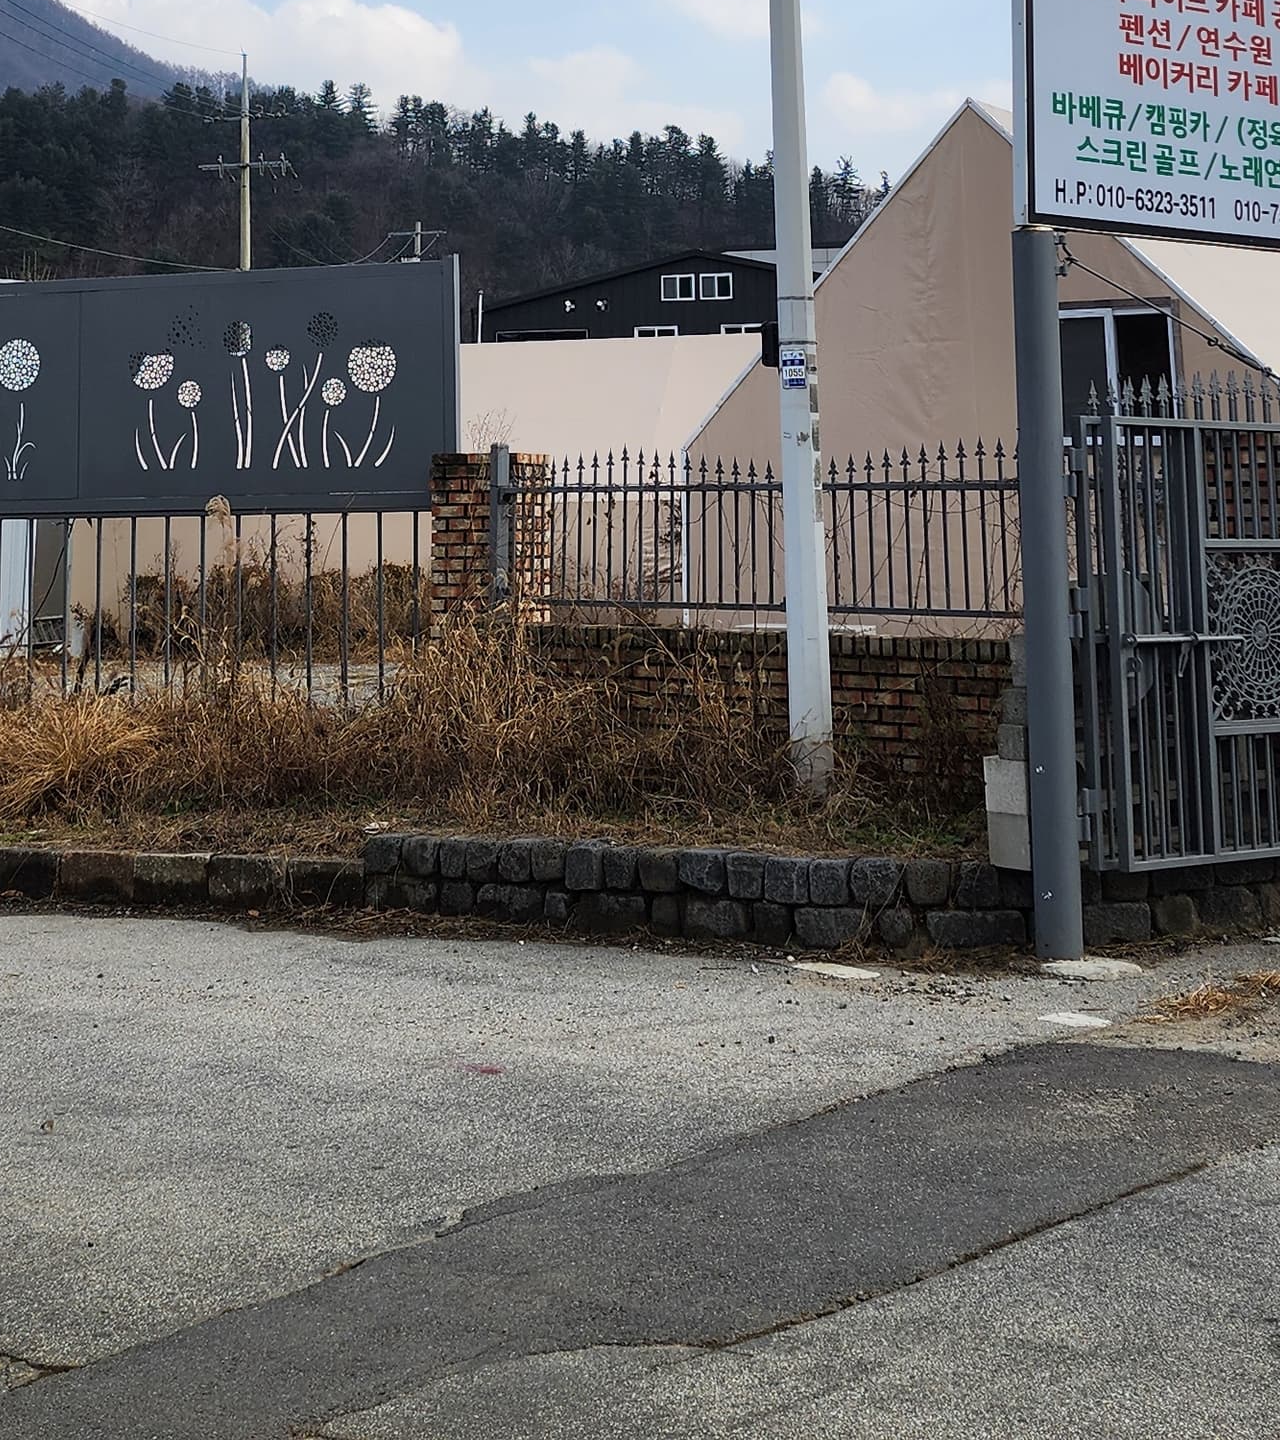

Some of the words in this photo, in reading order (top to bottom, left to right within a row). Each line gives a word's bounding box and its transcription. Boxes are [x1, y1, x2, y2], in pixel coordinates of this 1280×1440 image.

[1119, 53, 1218, 97] 베이커리
[1227, 70, 1279, 106] 카페
[1075, 135, 1147, 173] 스크린
[784, 367, 804, 378] 1055
